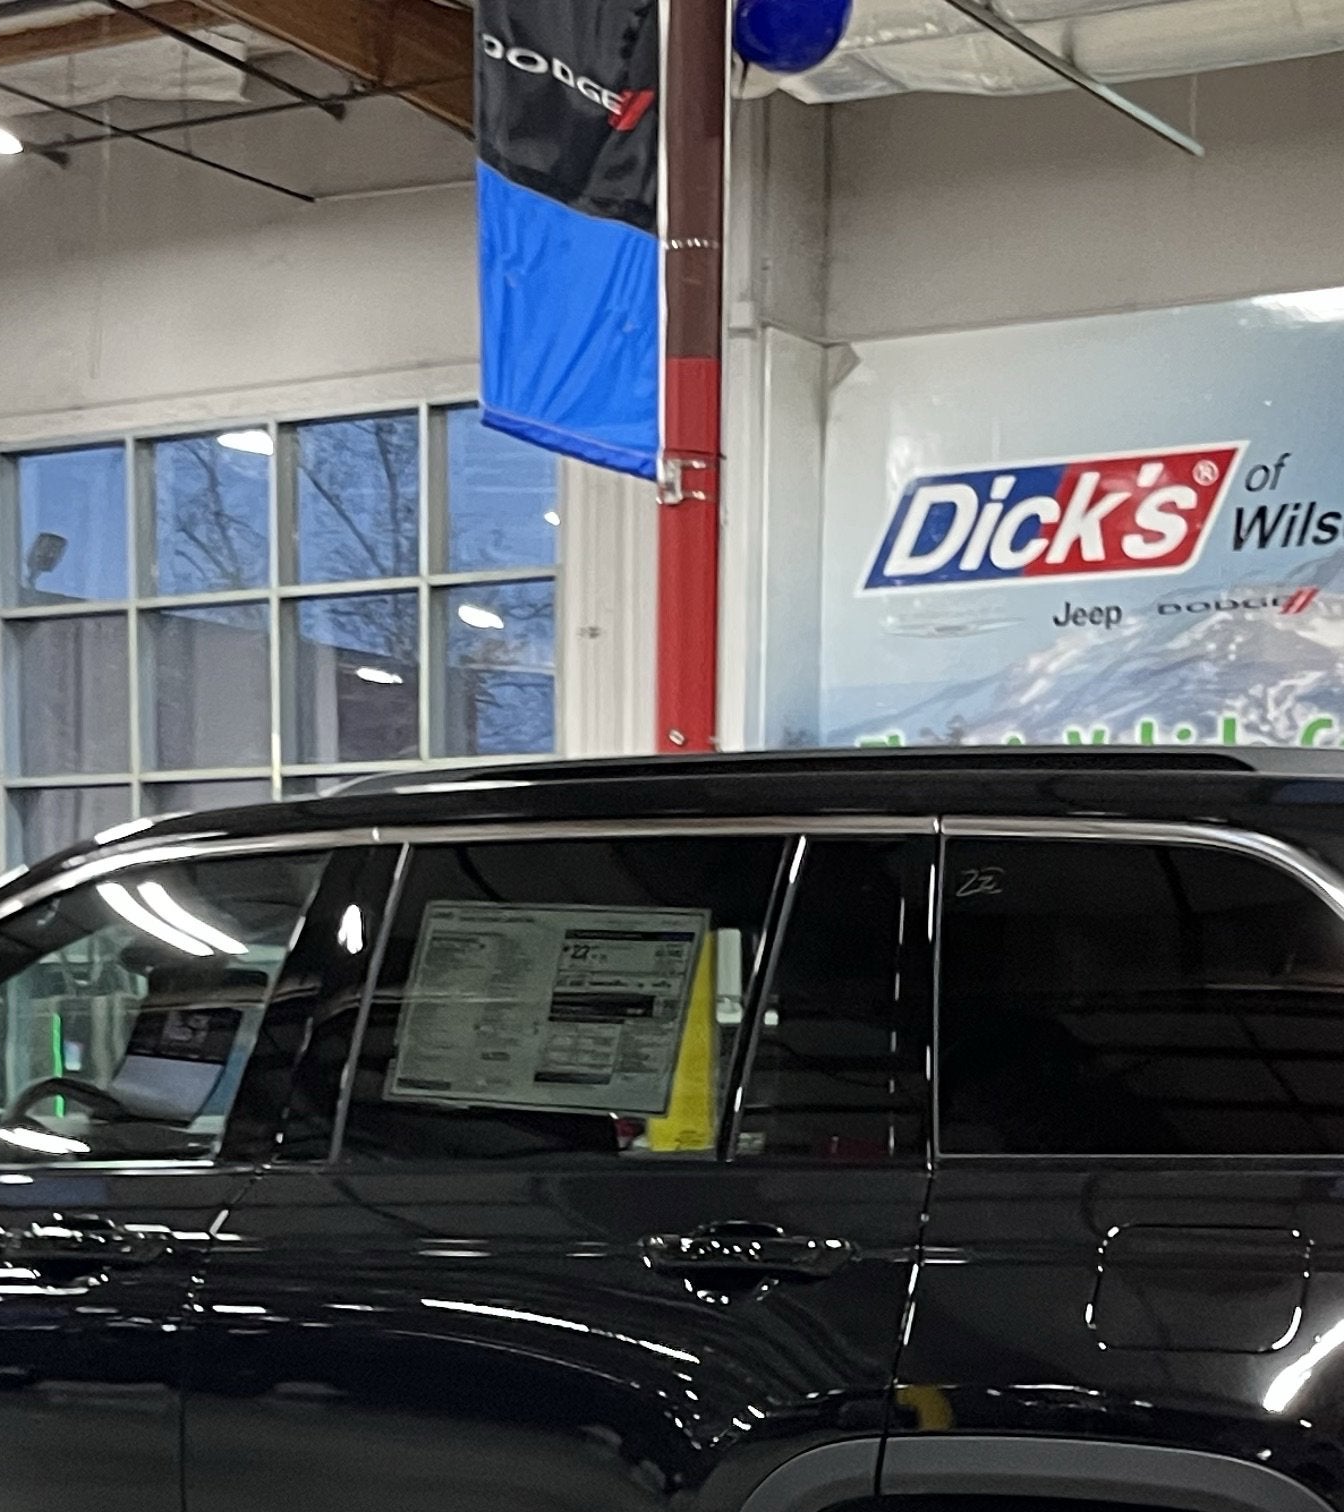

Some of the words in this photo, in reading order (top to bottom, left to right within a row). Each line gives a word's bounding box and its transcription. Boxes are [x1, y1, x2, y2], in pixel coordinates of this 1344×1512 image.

[481, 33, 623, 116] DODGE
[1245, 453, 1291, 494] of
[882, 464, 1200, 576] Dick's
[1053, 602, 1123, 631] Jeep
